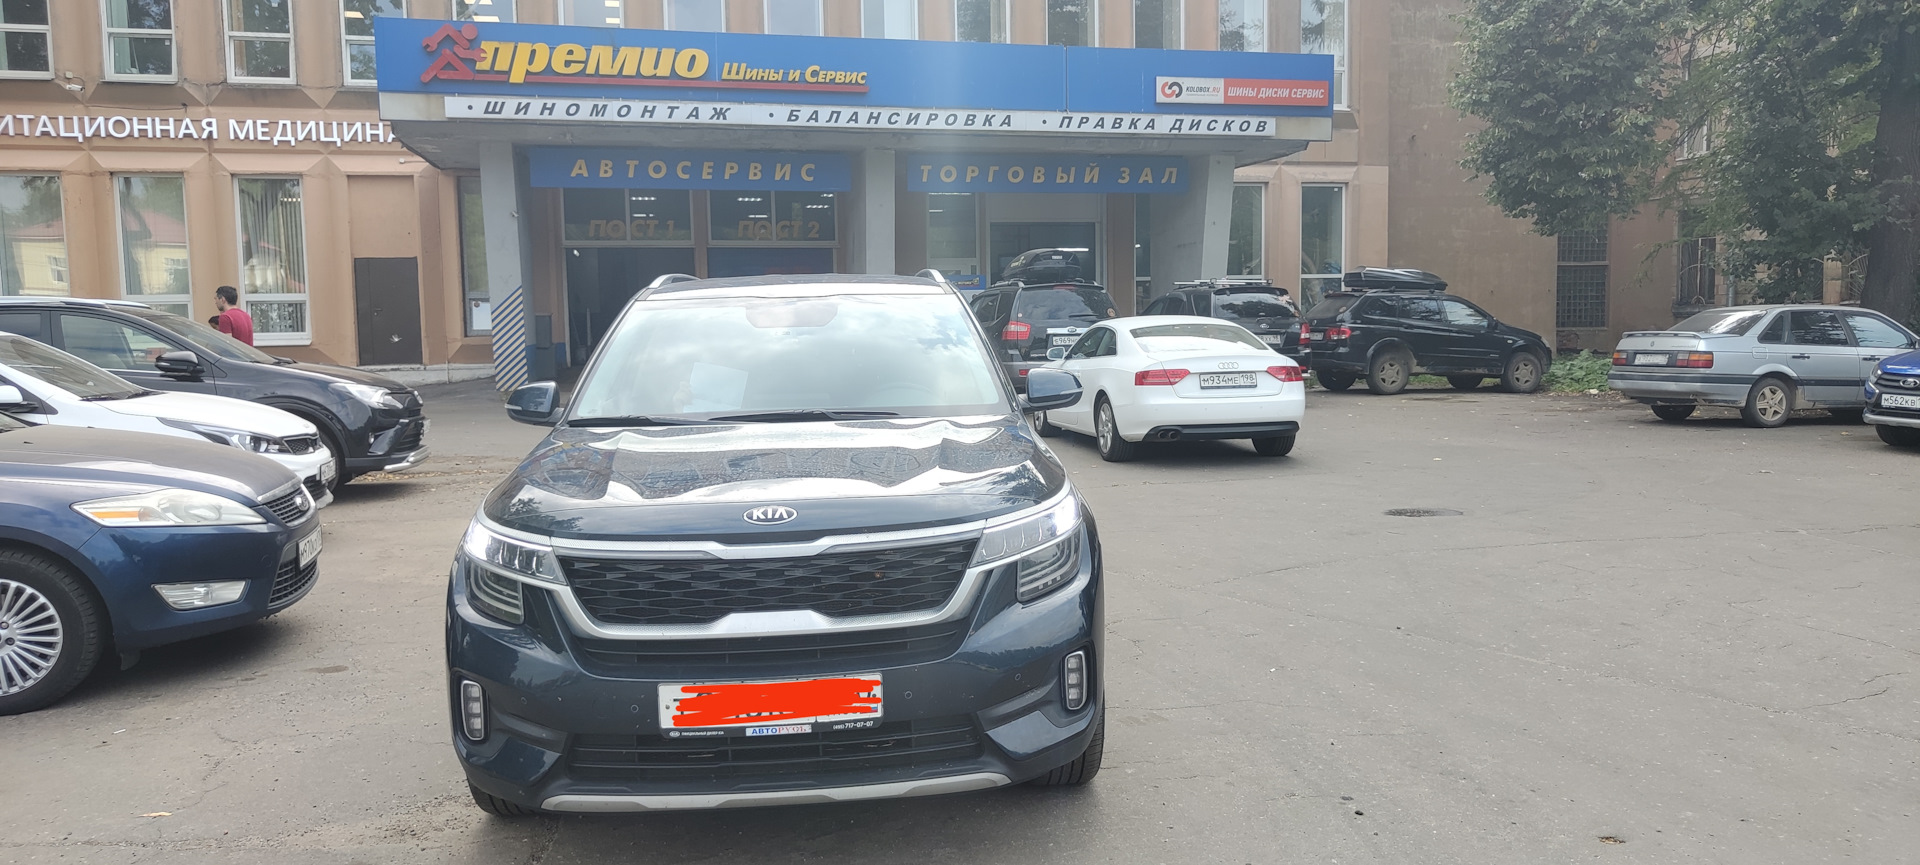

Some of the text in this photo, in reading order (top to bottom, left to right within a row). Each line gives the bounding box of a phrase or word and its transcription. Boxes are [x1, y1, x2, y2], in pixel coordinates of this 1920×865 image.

[475, 40, 710, 83] премио
[721, 62, 783, 82] Шины
[805, 65, 867, 85] Сервис
[1228, 87, 1256, 96] ШИНЫ
[1258, 88, 1289, 98] ДИСКИ
[1291, 89, 1325, 98] СЕРВИС
[483, 101, 732, 121] ШИНОМОНТАЖ
[786, 109, 1013, 128] БАЛАНСИРОВКА
[1058, 116, 1269, 134] ПРАВКА ДИСКОВ
[570, 159, 817, 182] АВТОСЕРВИС
[920, 162, 1180, 184] ТОРГОВЫЙ ЗАЛ
[588, 219, 675, 238] ПОСТ 1
[737, 220, 820, 239] ПОСТ 2
[1202, 375, 1239, 385] М934МЕ
[752, 507, 789, 520] KIA
[845, 721, 874, 729] 717-07-07
